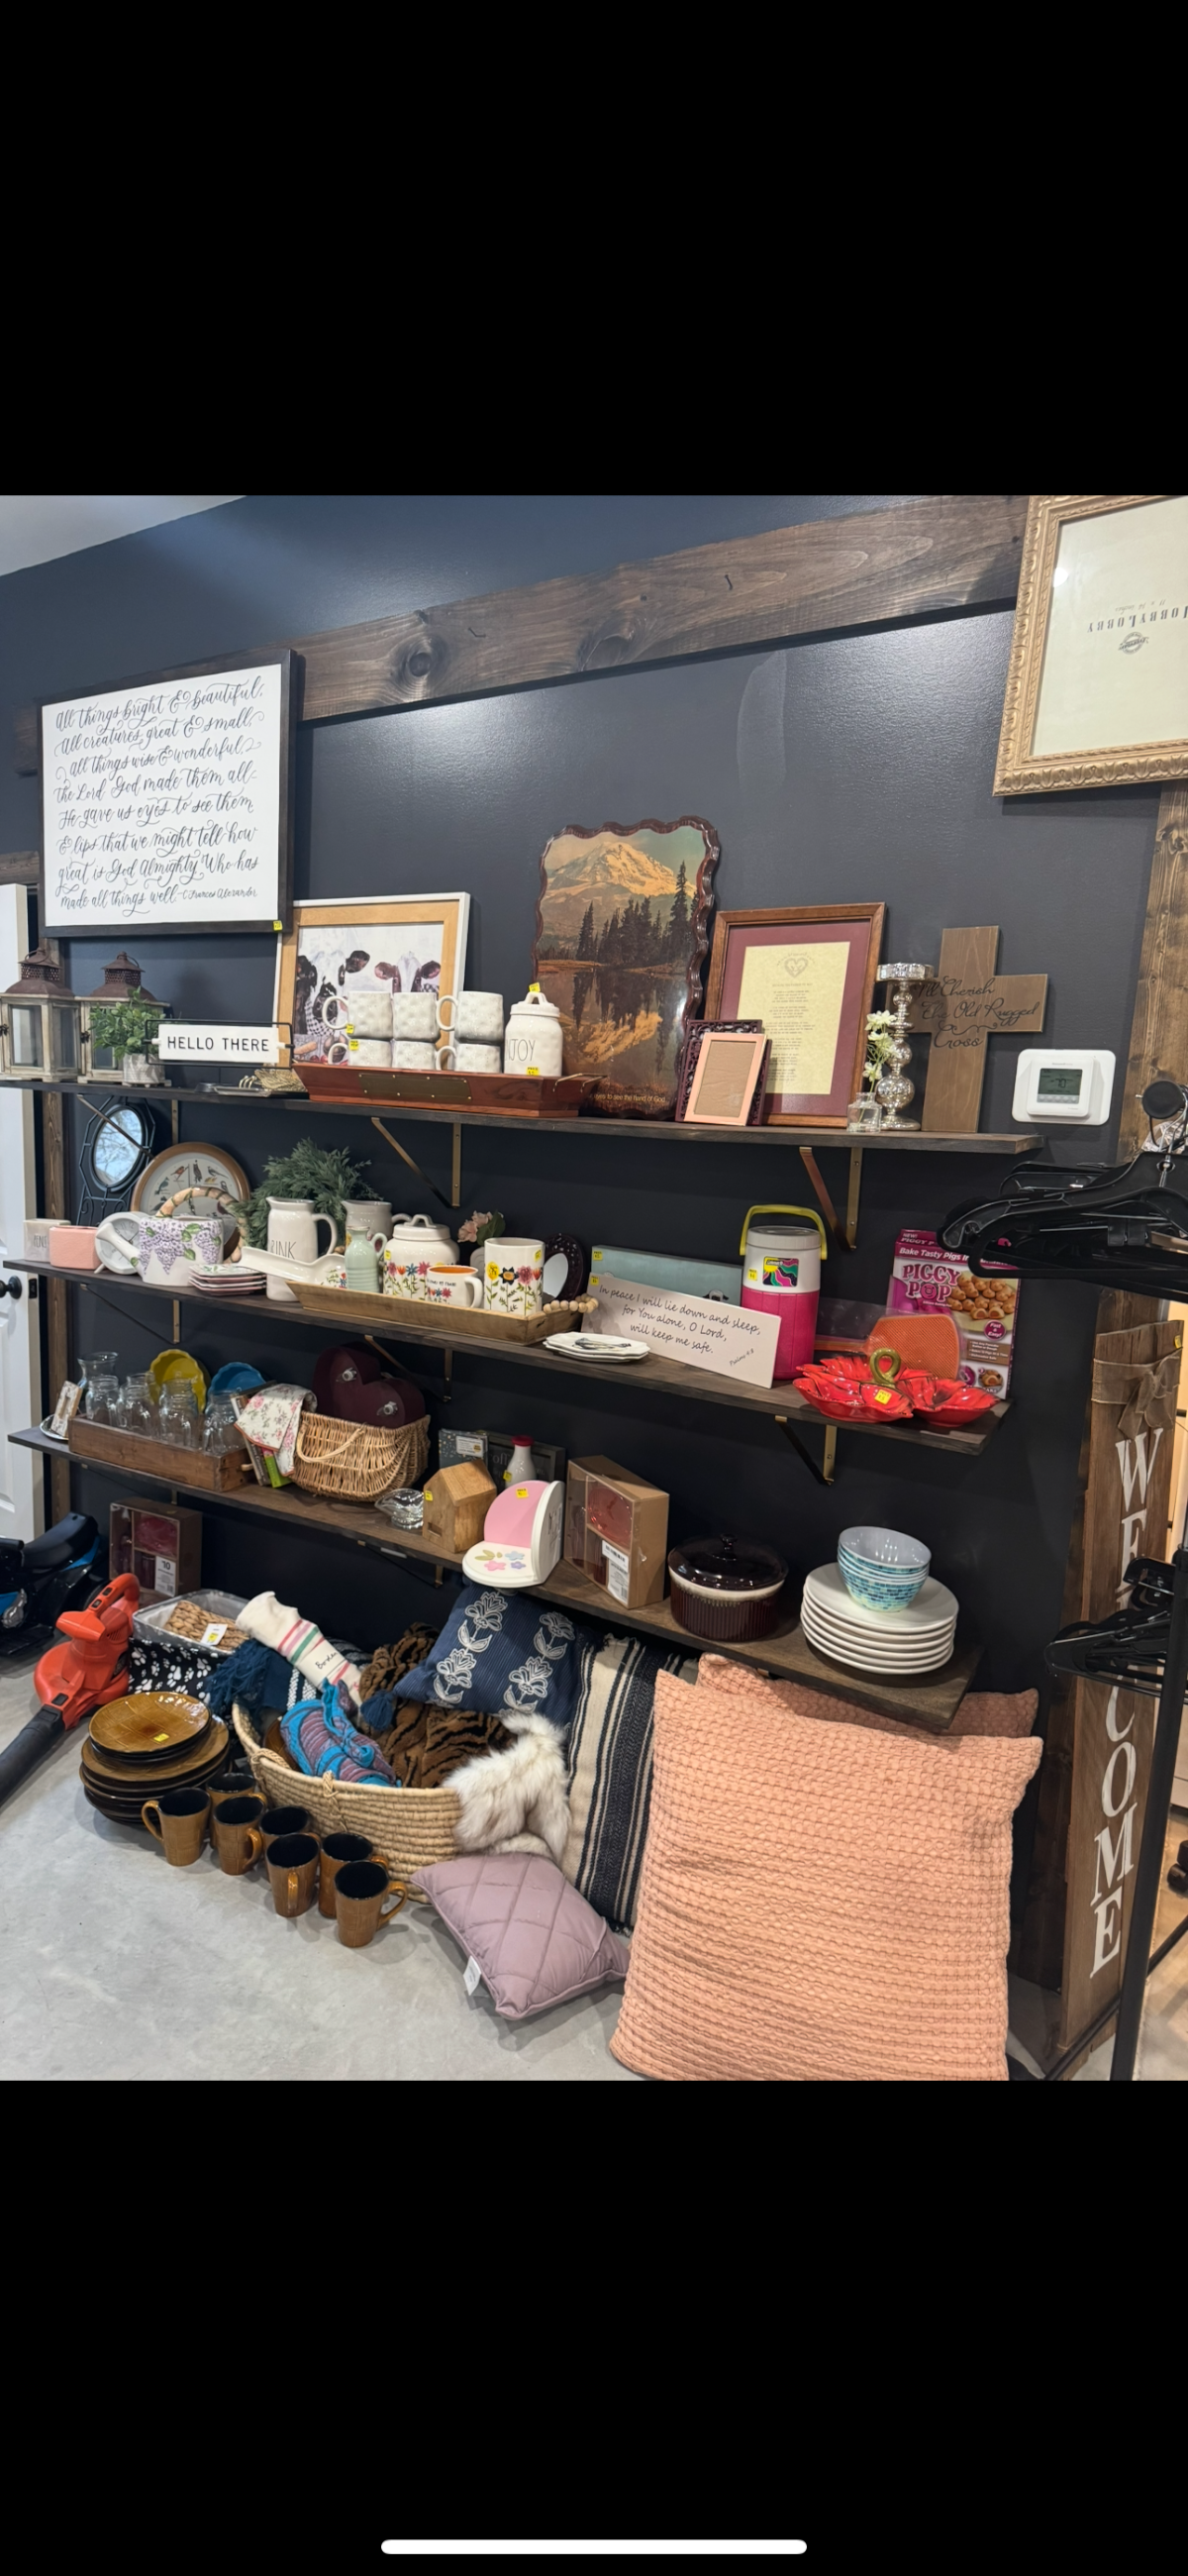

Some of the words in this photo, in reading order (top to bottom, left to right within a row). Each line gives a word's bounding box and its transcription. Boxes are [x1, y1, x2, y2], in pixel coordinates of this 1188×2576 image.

[76, 702, 123, 736] things
[123, 694, 170, 730] bright
[167, 689, 191, 714] &
[185, 675, 264, 710] beautiful,
[83, 727, 143, 750] creatures
[183, 715, 204, 738] &
[89, 747, 129, 780] things
[132, 754, 157, 769] wise
[158, 745, 174, 767] &
[76, 778, 105, 801] Lord
[111, 774, 142, 798] God
[144, 769, 182, 791] made
[180, 767, 225, 788] them
[58, 808, 81, 830] He
[79, 808, 116, 829] gave
[117, 805, 136, 821] us
[136, 800, 170, 827] eyes
[171, 793, 193, 815] to
[191, 798, 213, 812] see
[56, 835, 73, 855] &
[71, 835, 98, 859] lips
[98, 831, 136, 853] that
[132, 836, 148, 852] we
[150, 826, 194, 858] might
[195, 820, 226, 847] tell
[227, 821, 257, 844] how
[55, 857, 95, 897] great
[92, 865, 106, 880] is
[106, 859, 139, 882] God
[201, 853, 232, 874] Who
[234, 849, 258, 872] has
[60, 888, 89, 910] made
[92, 889, 109, 908] all
[109, 881, 149, 917] things
[940, 976, 995, 996] Cherish
[922, 999, 950, 1020] The
[953, 1000, 982, 1019] Old
[984, 997, 1040, 1027] Rugged
[167, 1036, 215, 1050] HELLO
[222, 1037, 270, 1052] THERE
[934, 1021, 991, 1049] Cross
[899, 1247, 919, 1256] Bake
[921, 1249, 942, 1260] Tasty
[942, 1252, 961, 1263] Pigs
[902, 1263, 962, 1287] PIGGY
[905, 1281, 952, 1302] POP
[599, 1285, 610, 1294] In
[610, 1288, 635, 1300] peace
[636, 1293, 641, 1302] I
[643, 1295, 662, 1308] will
[664, 1299, 679, 1312] lie
[679, 1303, 708, 1319] down
[709, 1313, 731, 1325] and
[732, 1317, 761, 1336] sleep,
[622, 1303, 636, 1316] for
[639, 1307, 655, 1319] You
[655, 1313, 686, 1331] alone,
[689, 1321, 698, 1332] O
[699, 1324, 728, 1342] Lord,
[630, 1322, 649, 1336] will
[651, 1326, 674, 1343] keep
[675, 1336, 691, 1347] me
[691, 1341, 714, 1355] safe.
[730, 1353, 745, 1367] Psalms
[161, 1560, 171, 1571] 10
[1090, 1427, 1164, 1980] WECOME
